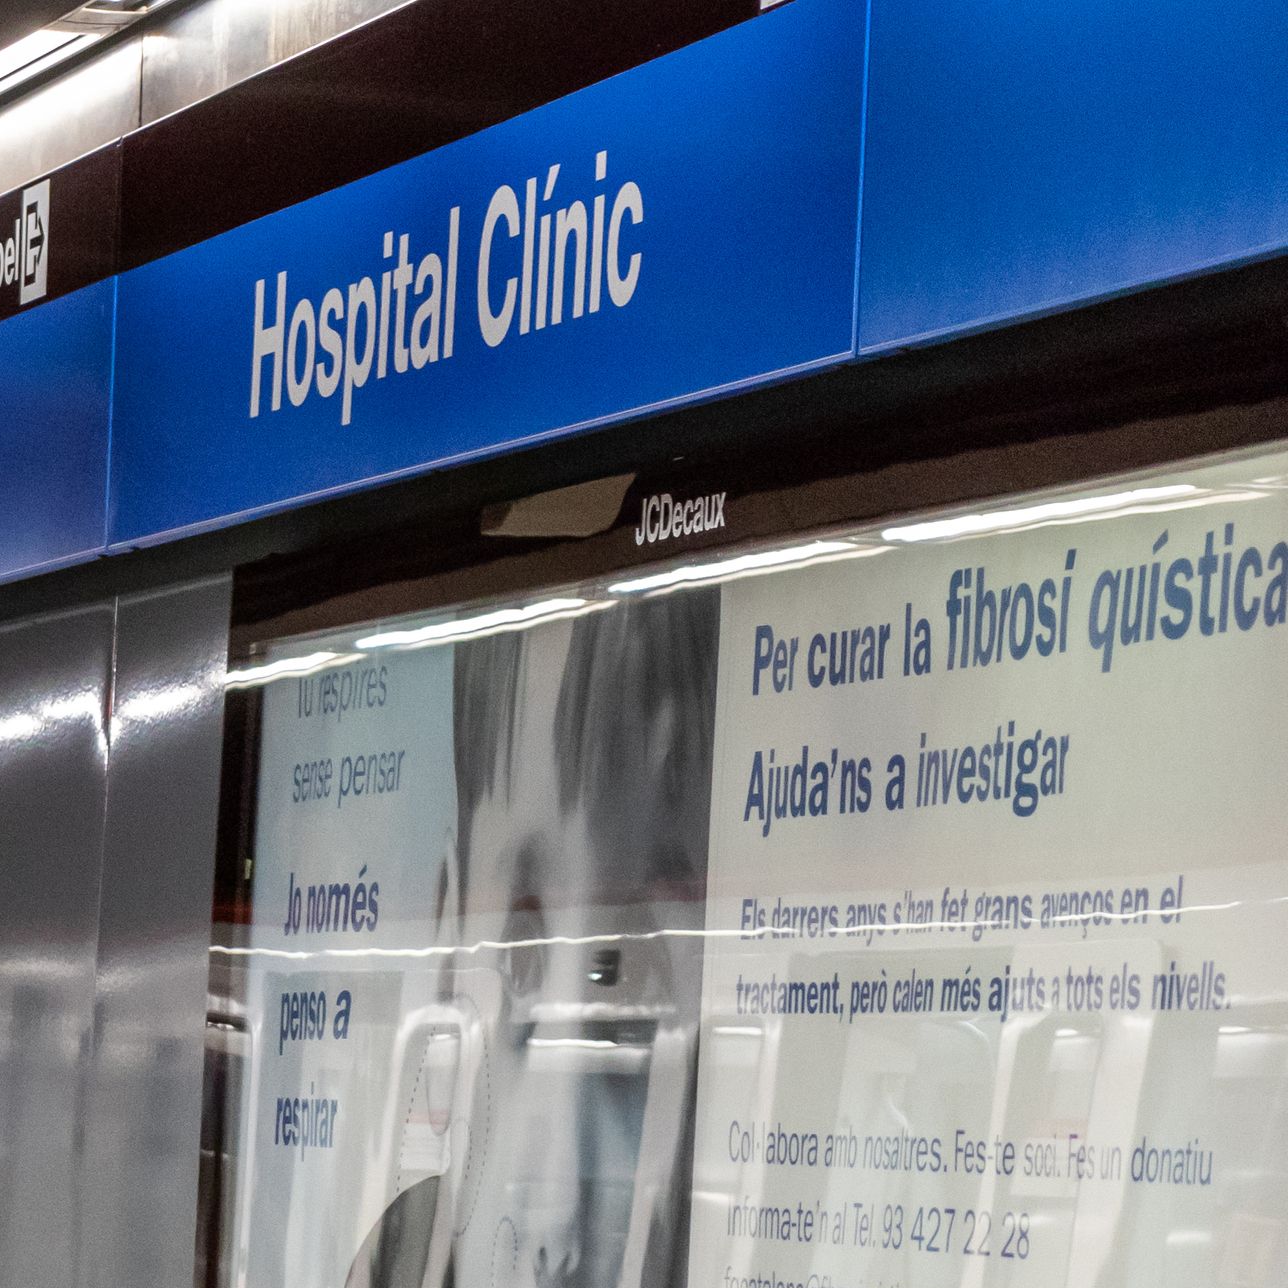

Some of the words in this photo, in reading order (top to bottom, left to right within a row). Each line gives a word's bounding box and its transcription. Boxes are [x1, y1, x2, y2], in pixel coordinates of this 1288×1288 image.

[250, 206, 460, 426] Hospital
[477, 149, 644, 348] Clínic
[635, 491, 726, 546] JCDecaux
[752, 625, 798, 696] Per
[807, 621, 891, 689] curar
[903, 602, 932, 678] la
[946, 548, 1078, 671] fibrosi
[1088, 522, 1288, 673] quística
[318, 659, 388, 723] respires
[293, 755, 333, 803] sense
[338, 749, 406, 808] pensar
[742, 745, 872, 838] Ajuda'ns
[884, 755, 906, 811] a
[916, 720, 1070, 818] investigar
[284, 872, 302, 936] Jo
[306, 865, 379, 935] només
[741, 898, 766, 940] Els
[771, 897, 838, 939] darrers
[846, 902, 887, 946] anys
[940, 887, 969, 932] fet
[971, 891, 1033, 942] grans
[1040, 887, 1114, 939] avenços
[1120, 887, 1150, 926] en
[1159, 874, 1184, 924] el
[280, 990, 327, 1056] penso
[333, 989, 352, 1040] a
[736, 972, 844, 1024] tractament,
[850, 969, 888, 1024] però
[892, 968, 935, 1014] calen
[940, 965, 981, 1014] més
[988, 964, 1046, 1023] ajuts
[1050, 976, 1061, 1012] a
[1065, 966, 1104, 1012] tots
[1109, 962, 1141, 1010] els
[1151, 960, 1232, 1011] nivells.
[275, 1081, 338, 1162] respirar
[824, 1126, 857, 1169] amb
[862, 1126, 948, 1173] nosaltres.
[954, 1129, 1015, 1176] Fes-te
[1023, 1133, 1061, 1178] soci.
[1067, 1133, 1095, 1180] Fes
[1100, 1143, 1122, 1181] un
[1130, 1136, 1213, 1186] donatiu
[832, 1201, 848, 1246] al
[853, 1202, 877, 1248] Tel.
[882, 1204, 904, 1250] 93
[910, 1207, 956, 1253] 427
[963, 1209, 992, 1256] 22
[1001, 1211, 1031, 1260] 28
